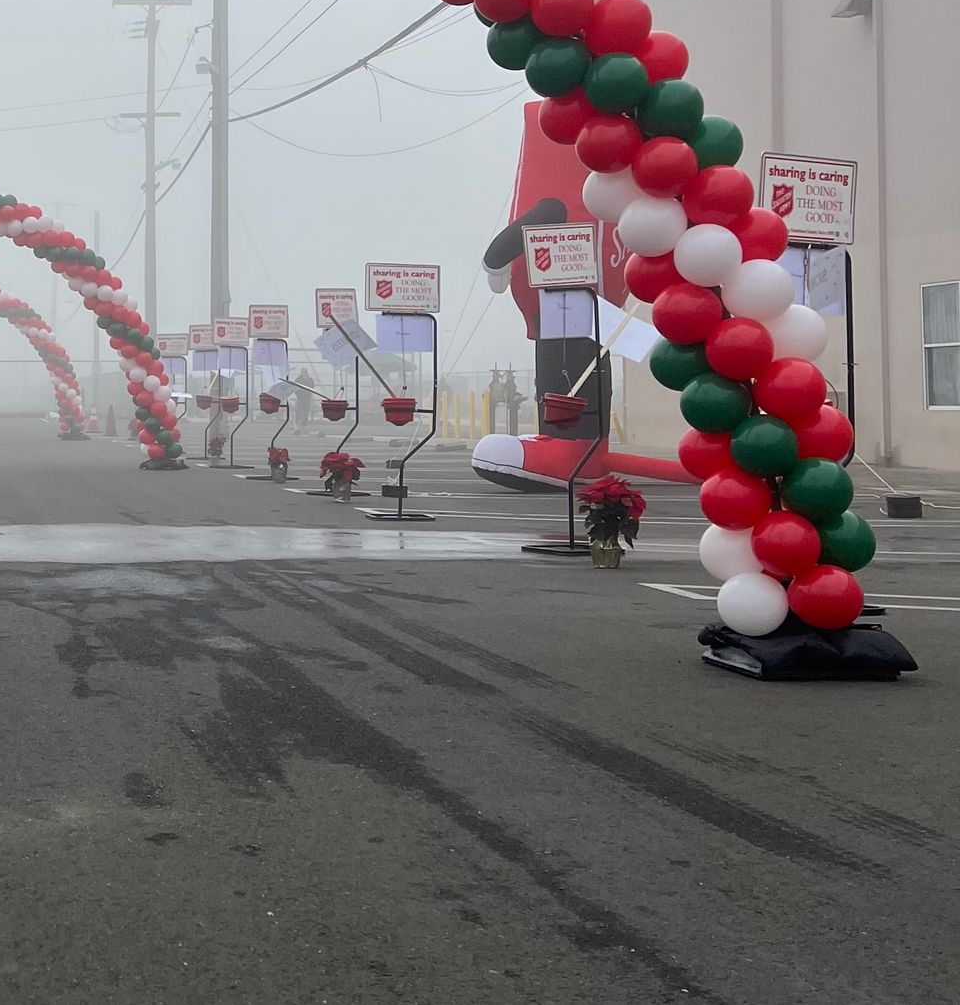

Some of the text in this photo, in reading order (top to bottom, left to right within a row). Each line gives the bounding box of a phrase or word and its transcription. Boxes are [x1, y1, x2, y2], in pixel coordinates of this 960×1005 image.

[769, 165, 849, 186] sharing is caring
[806, 185, 837, 197] DOING
[797, 198, 816, 209] THE
[818, 200, 844, 212] MOST
[805, 212, 834, 224] GOOD
[530, 232, 591, 244] sharing is caring
[558, 244, 582, 252] DOING
[554, 254, 568, 263] THE
[568, 253, 589, 262] MOST
[561, 264, 583, 272] GOOD
[373, 269, 401, 278] sharing
[411, 271, 435, 280] caring
